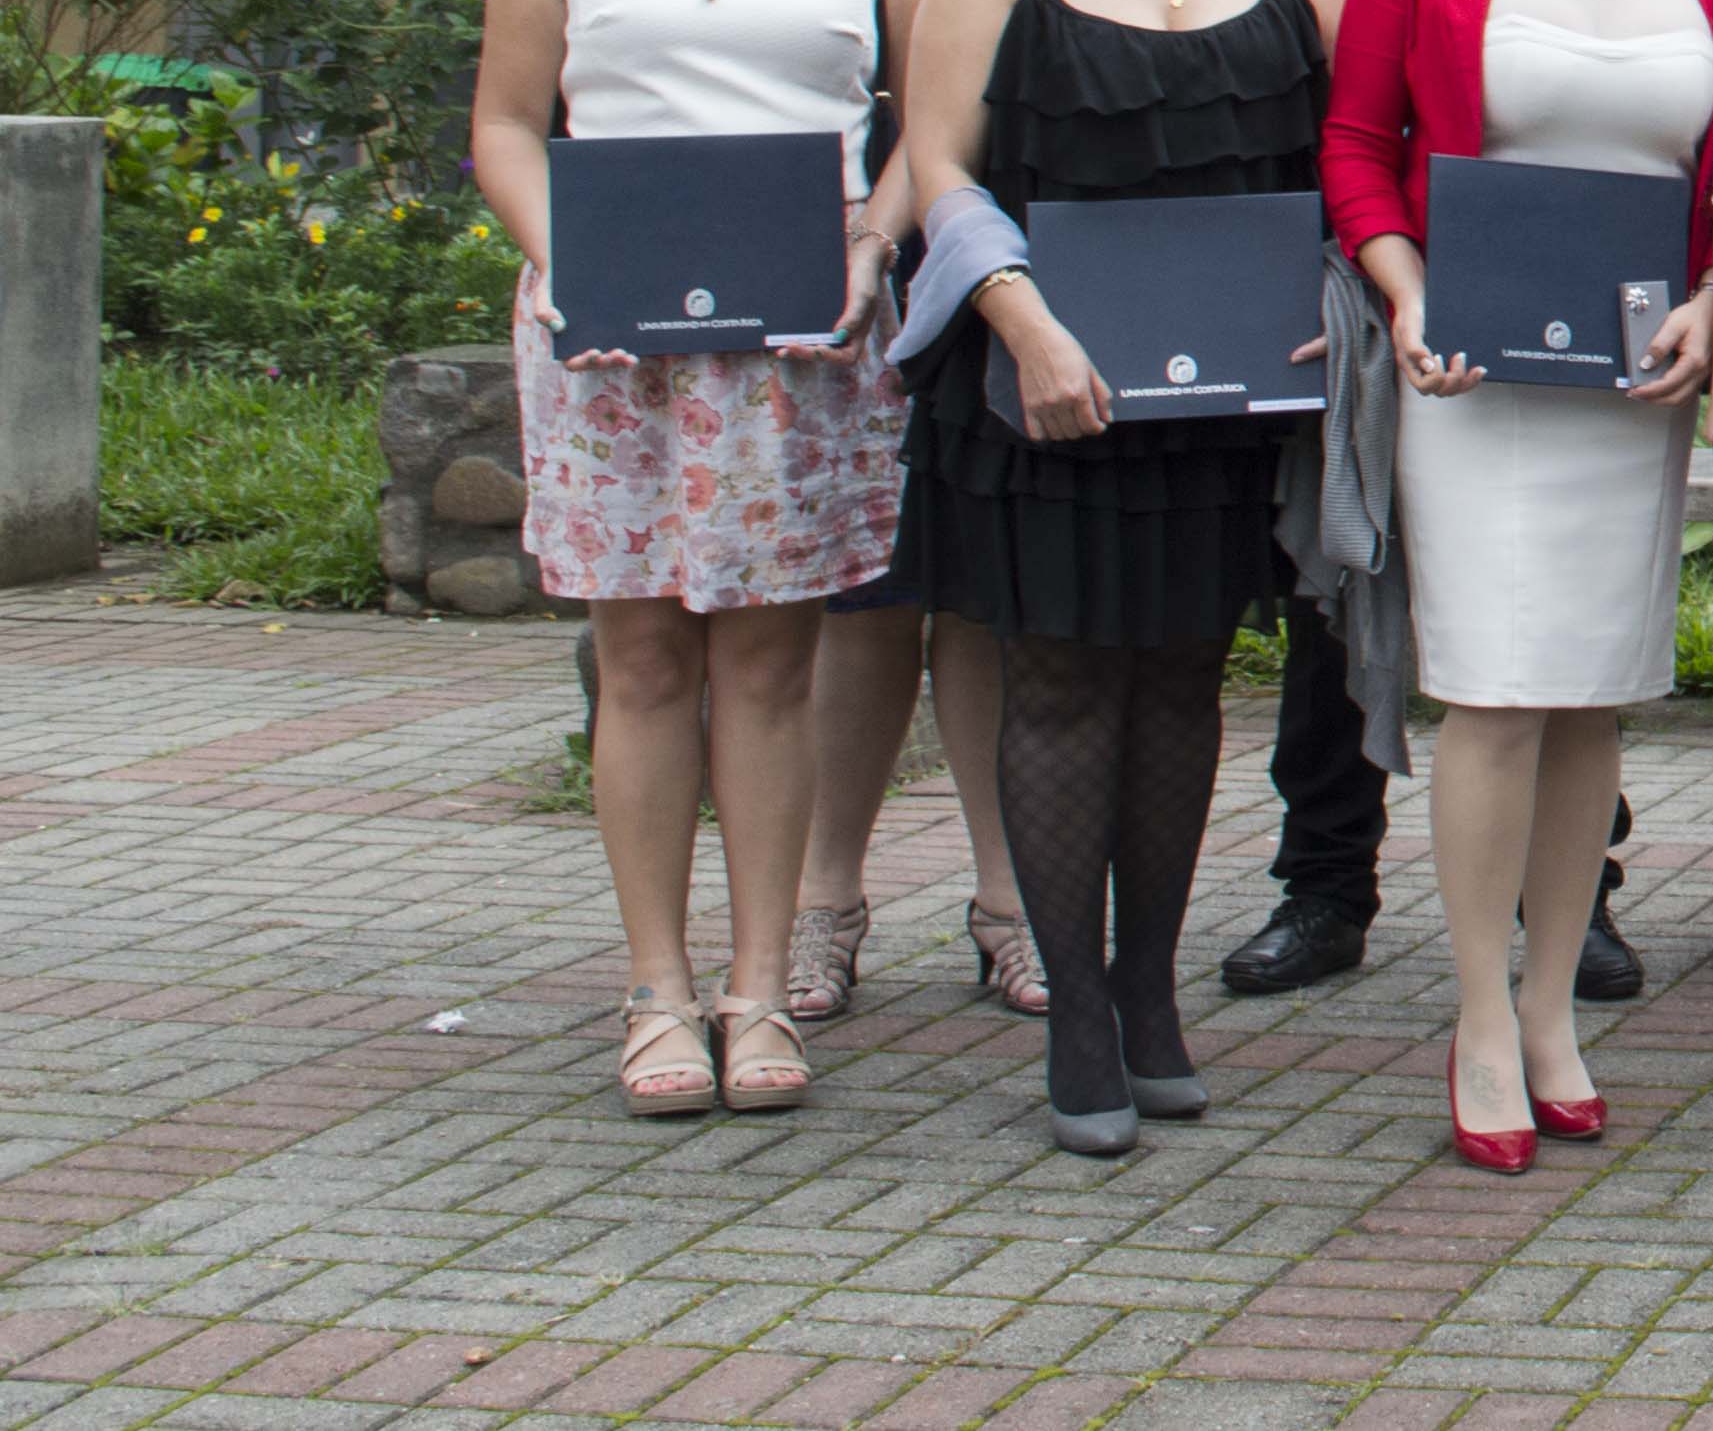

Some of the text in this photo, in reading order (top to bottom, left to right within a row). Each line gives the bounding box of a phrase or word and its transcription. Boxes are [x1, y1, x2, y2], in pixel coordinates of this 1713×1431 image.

[638, 322, 699, 331] UNIVERSIDAD
[711, 319, 740, 328] COSTA
[740, 318, 764, 327] RICA
[1502, 348, 1556, 361] UNIVERSIDAD
[1567, 354, 1592, 362] COSTA
[1592, 356, 1613, 364] RICA
[1120, 388, 1182, 398] UNIVERSIDAD
[1193, 385, 1222, 395] COSTA
[1222, 384, 1247, 393] RICA
